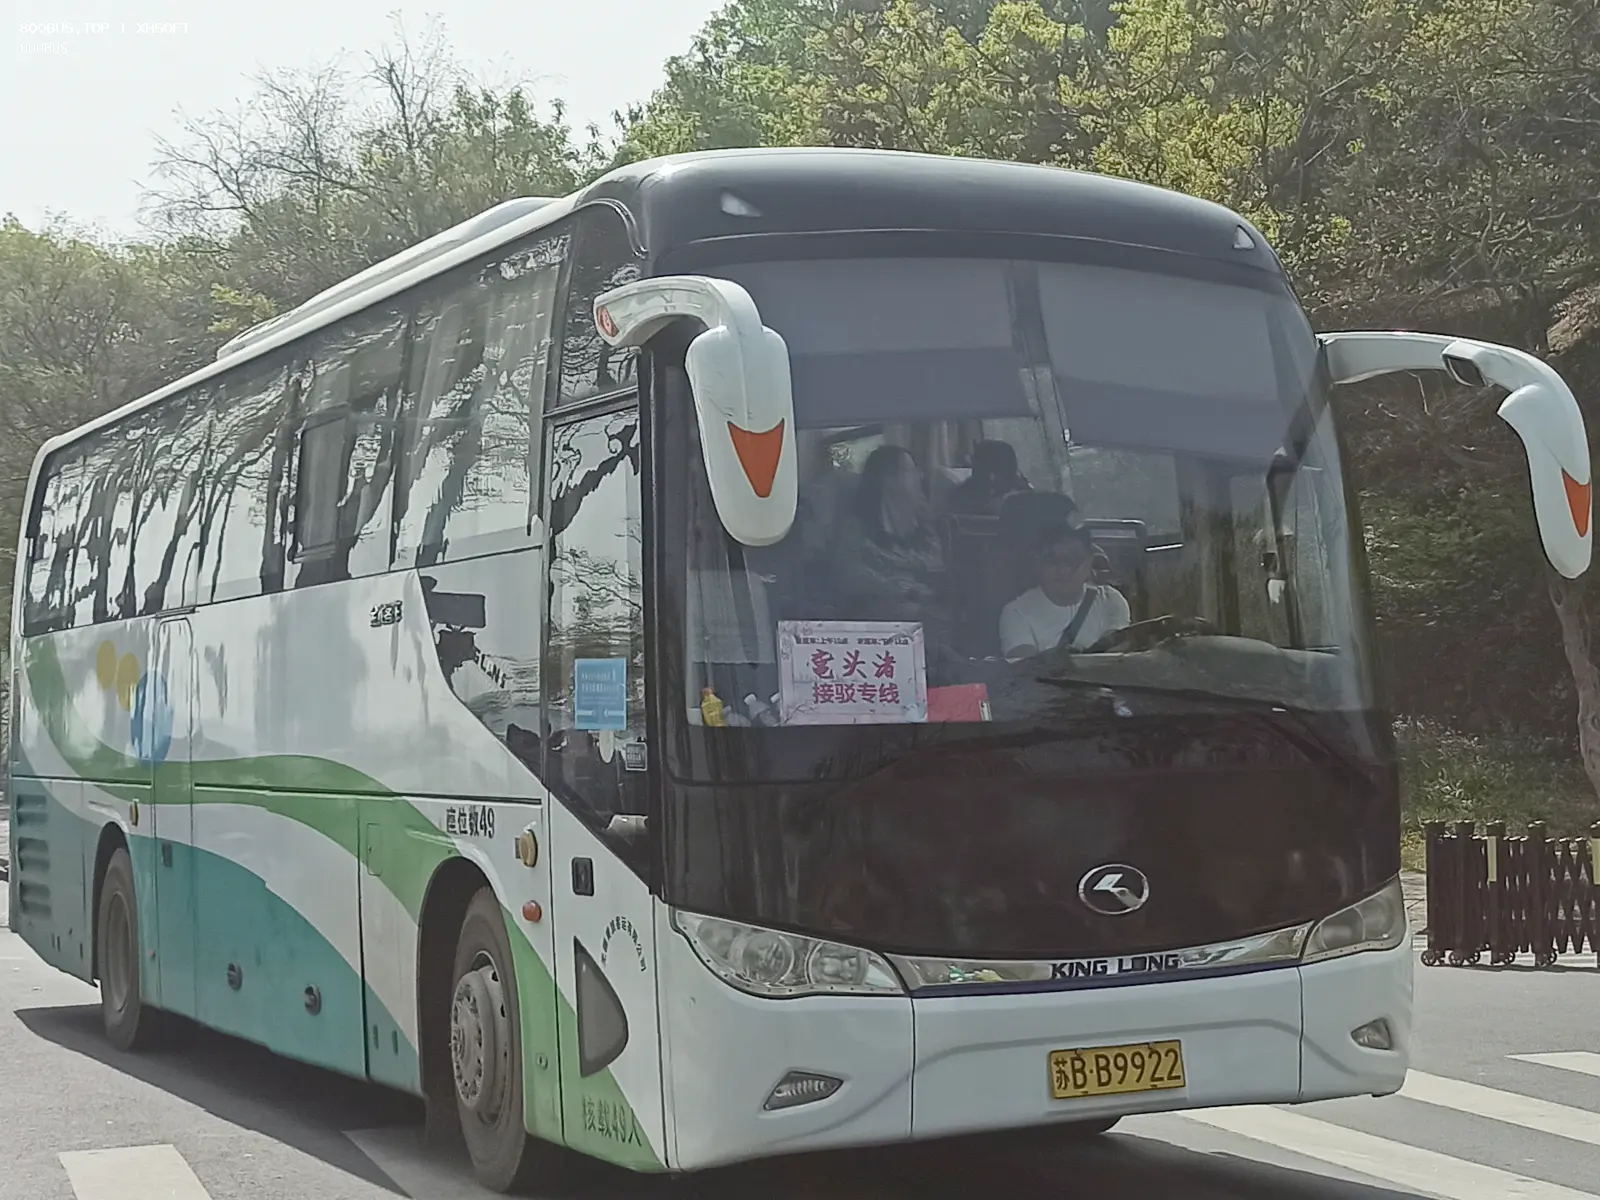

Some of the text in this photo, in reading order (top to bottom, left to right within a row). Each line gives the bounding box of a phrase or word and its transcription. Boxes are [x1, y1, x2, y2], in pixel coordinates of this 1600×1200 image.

[813, 682, 900, 705] 接驳专线
[446, 805, 495, 839] 座位数49
[1050, 953, 1180, 979] KING LONG
